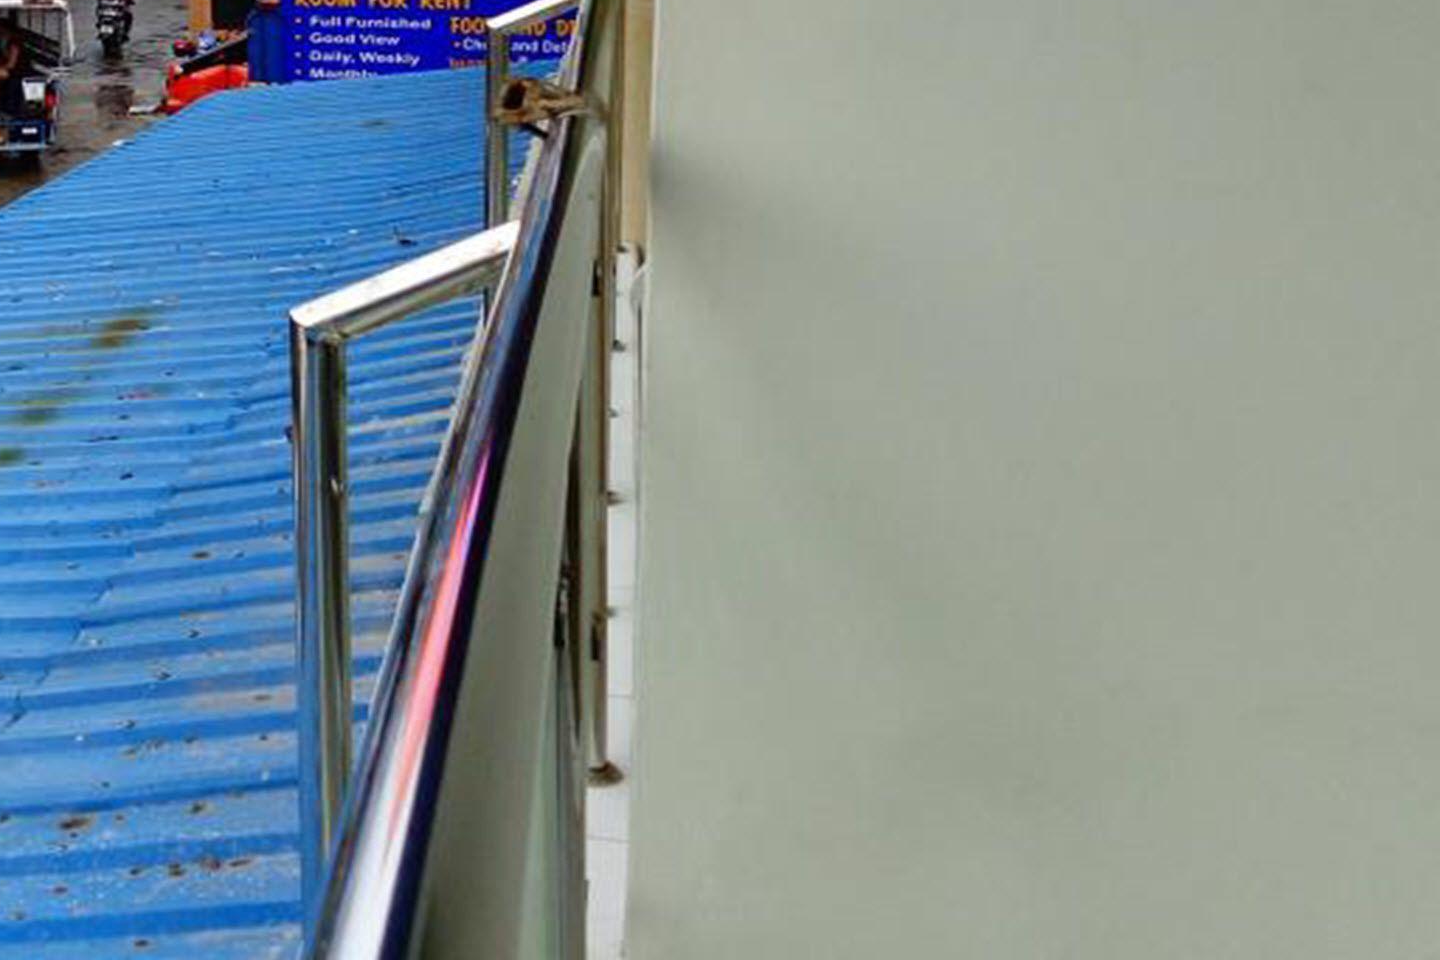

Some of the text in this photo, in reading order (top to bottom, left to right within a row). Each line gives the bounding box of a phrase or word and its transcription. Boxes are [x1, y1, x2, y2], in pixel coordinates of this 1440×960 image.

[309, 15, 432, 31] Full Furnished
[309, 32, 400, 47] Good View
[359, 50, 421, 68] Weekly
